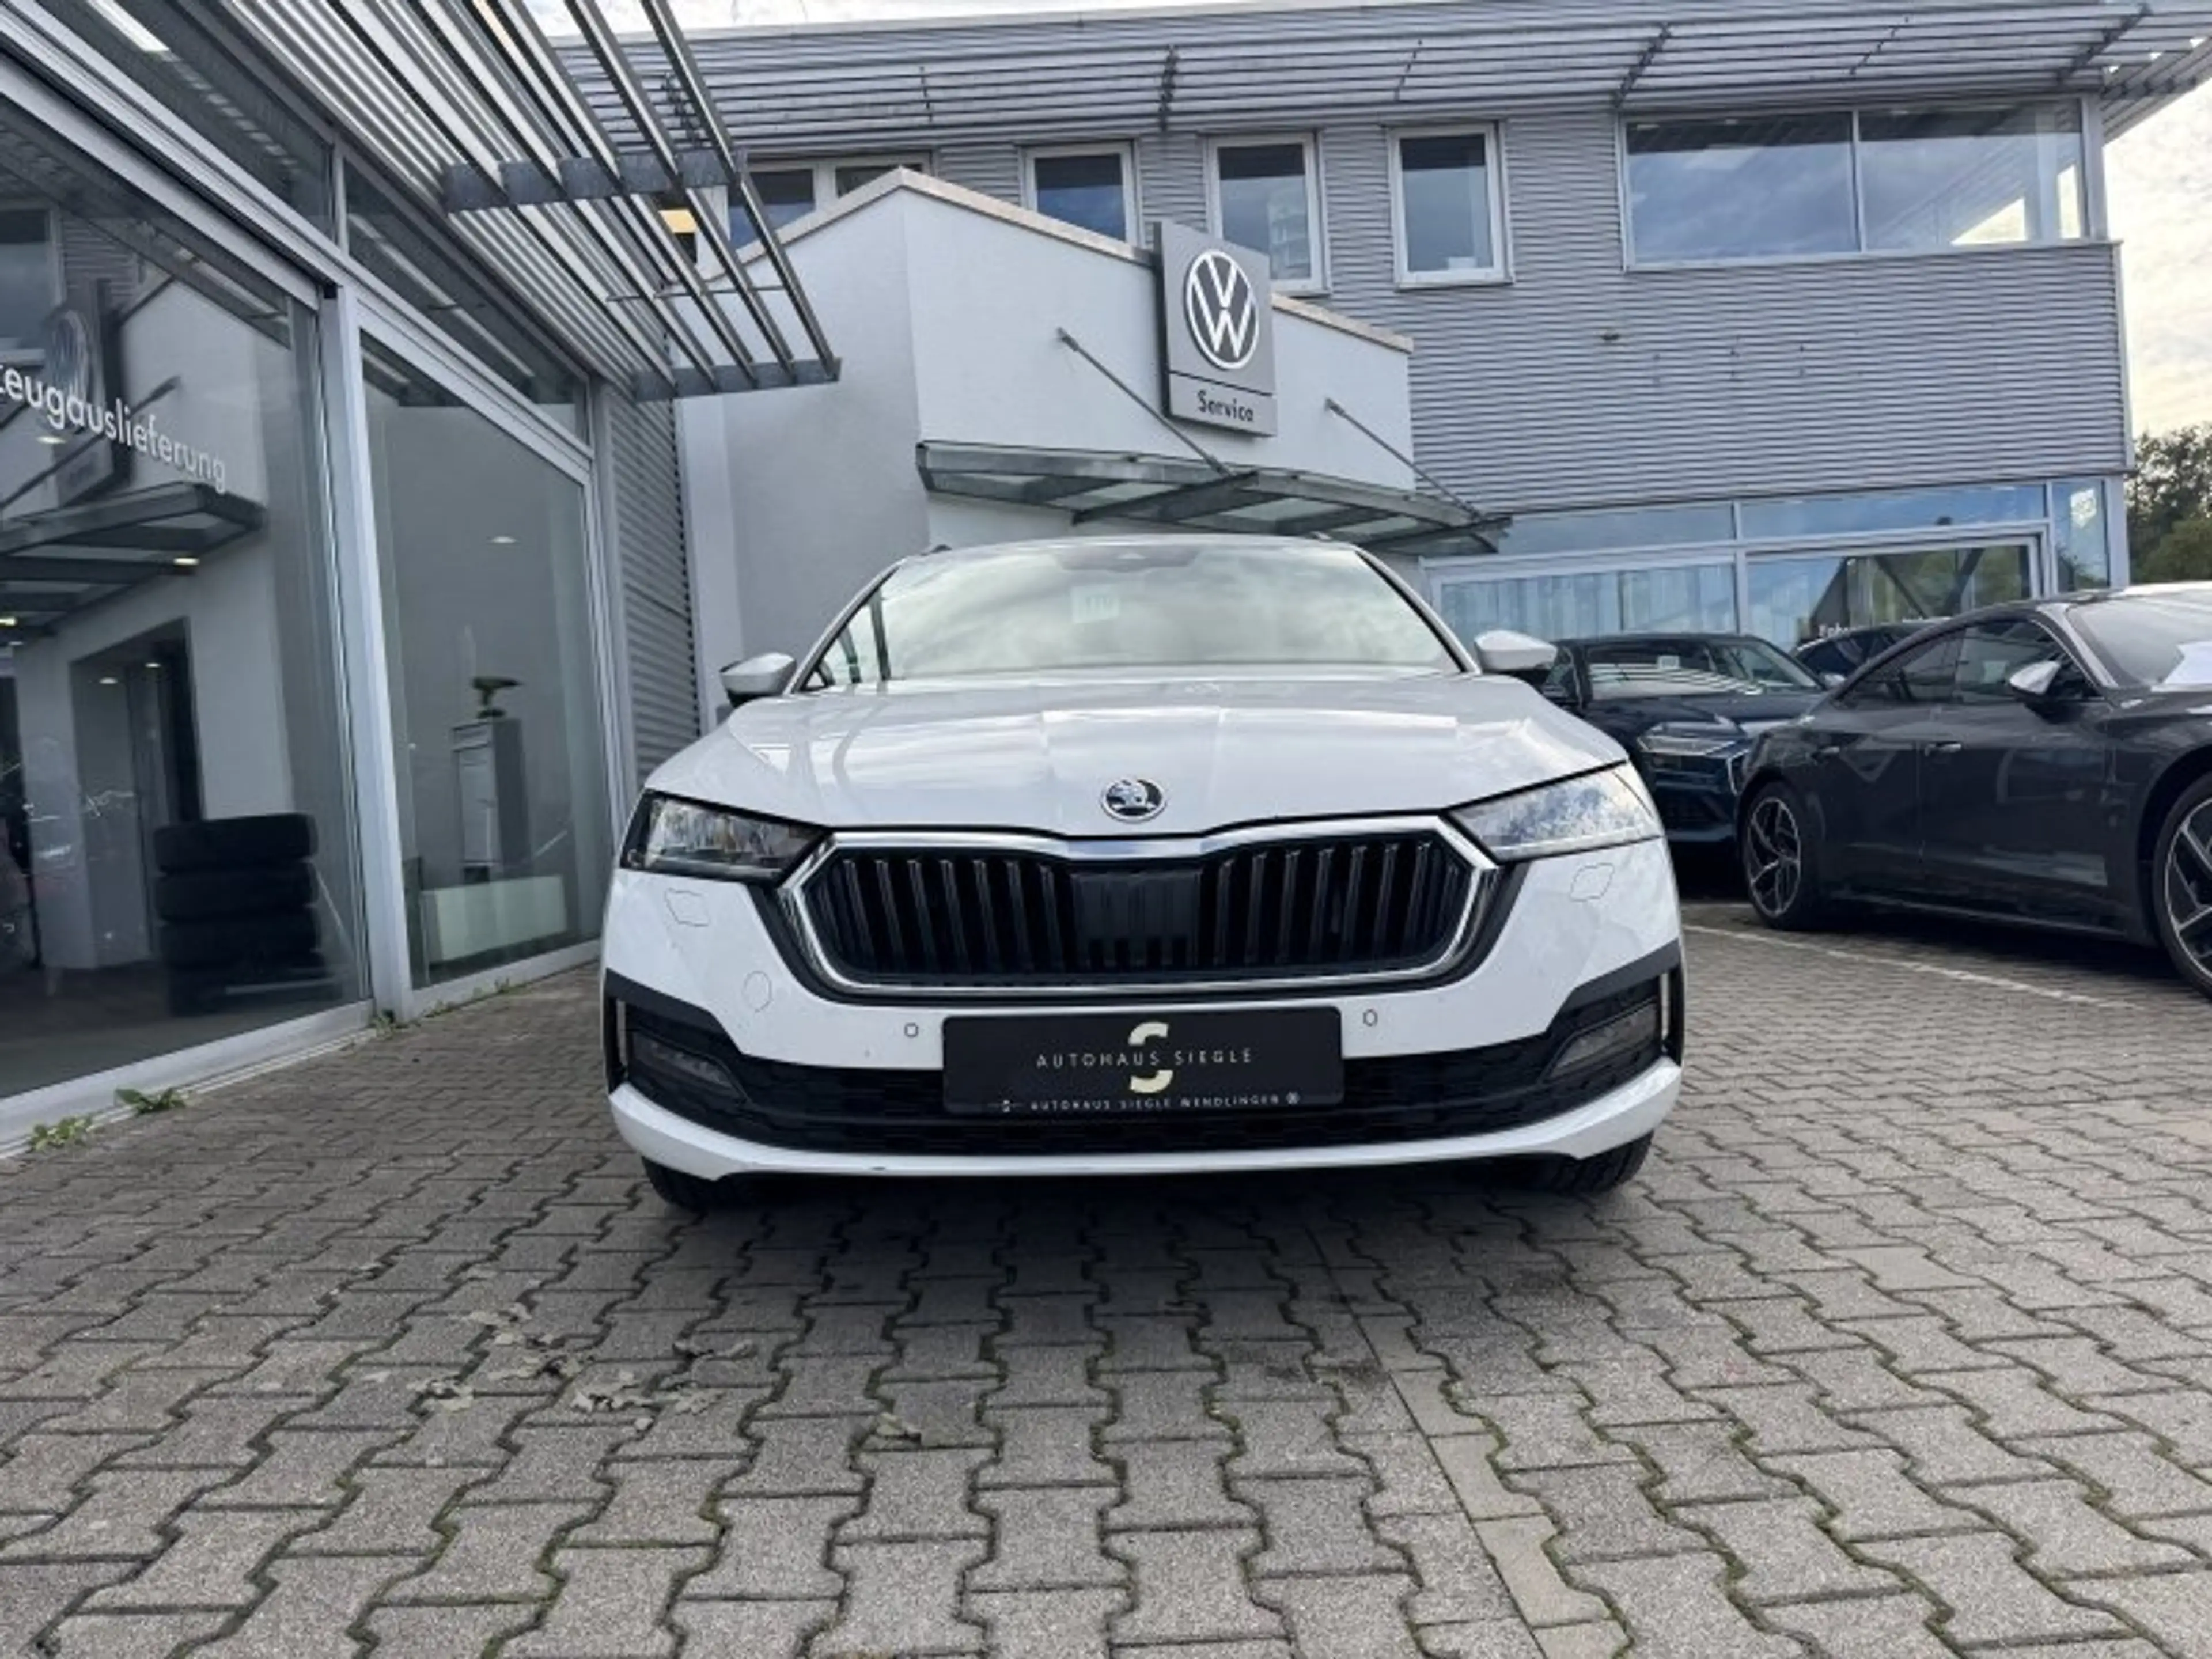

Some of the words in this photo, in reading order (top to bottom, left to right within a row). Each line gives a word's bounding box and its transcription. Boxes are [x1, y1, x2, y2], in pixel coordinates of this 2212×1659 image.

[1198, 389, 1253, 422] Service
[1036, 1051, 1160, 1069] AUTOHAUS
[1174, 1047, 1252, 1066] SIEGLE
